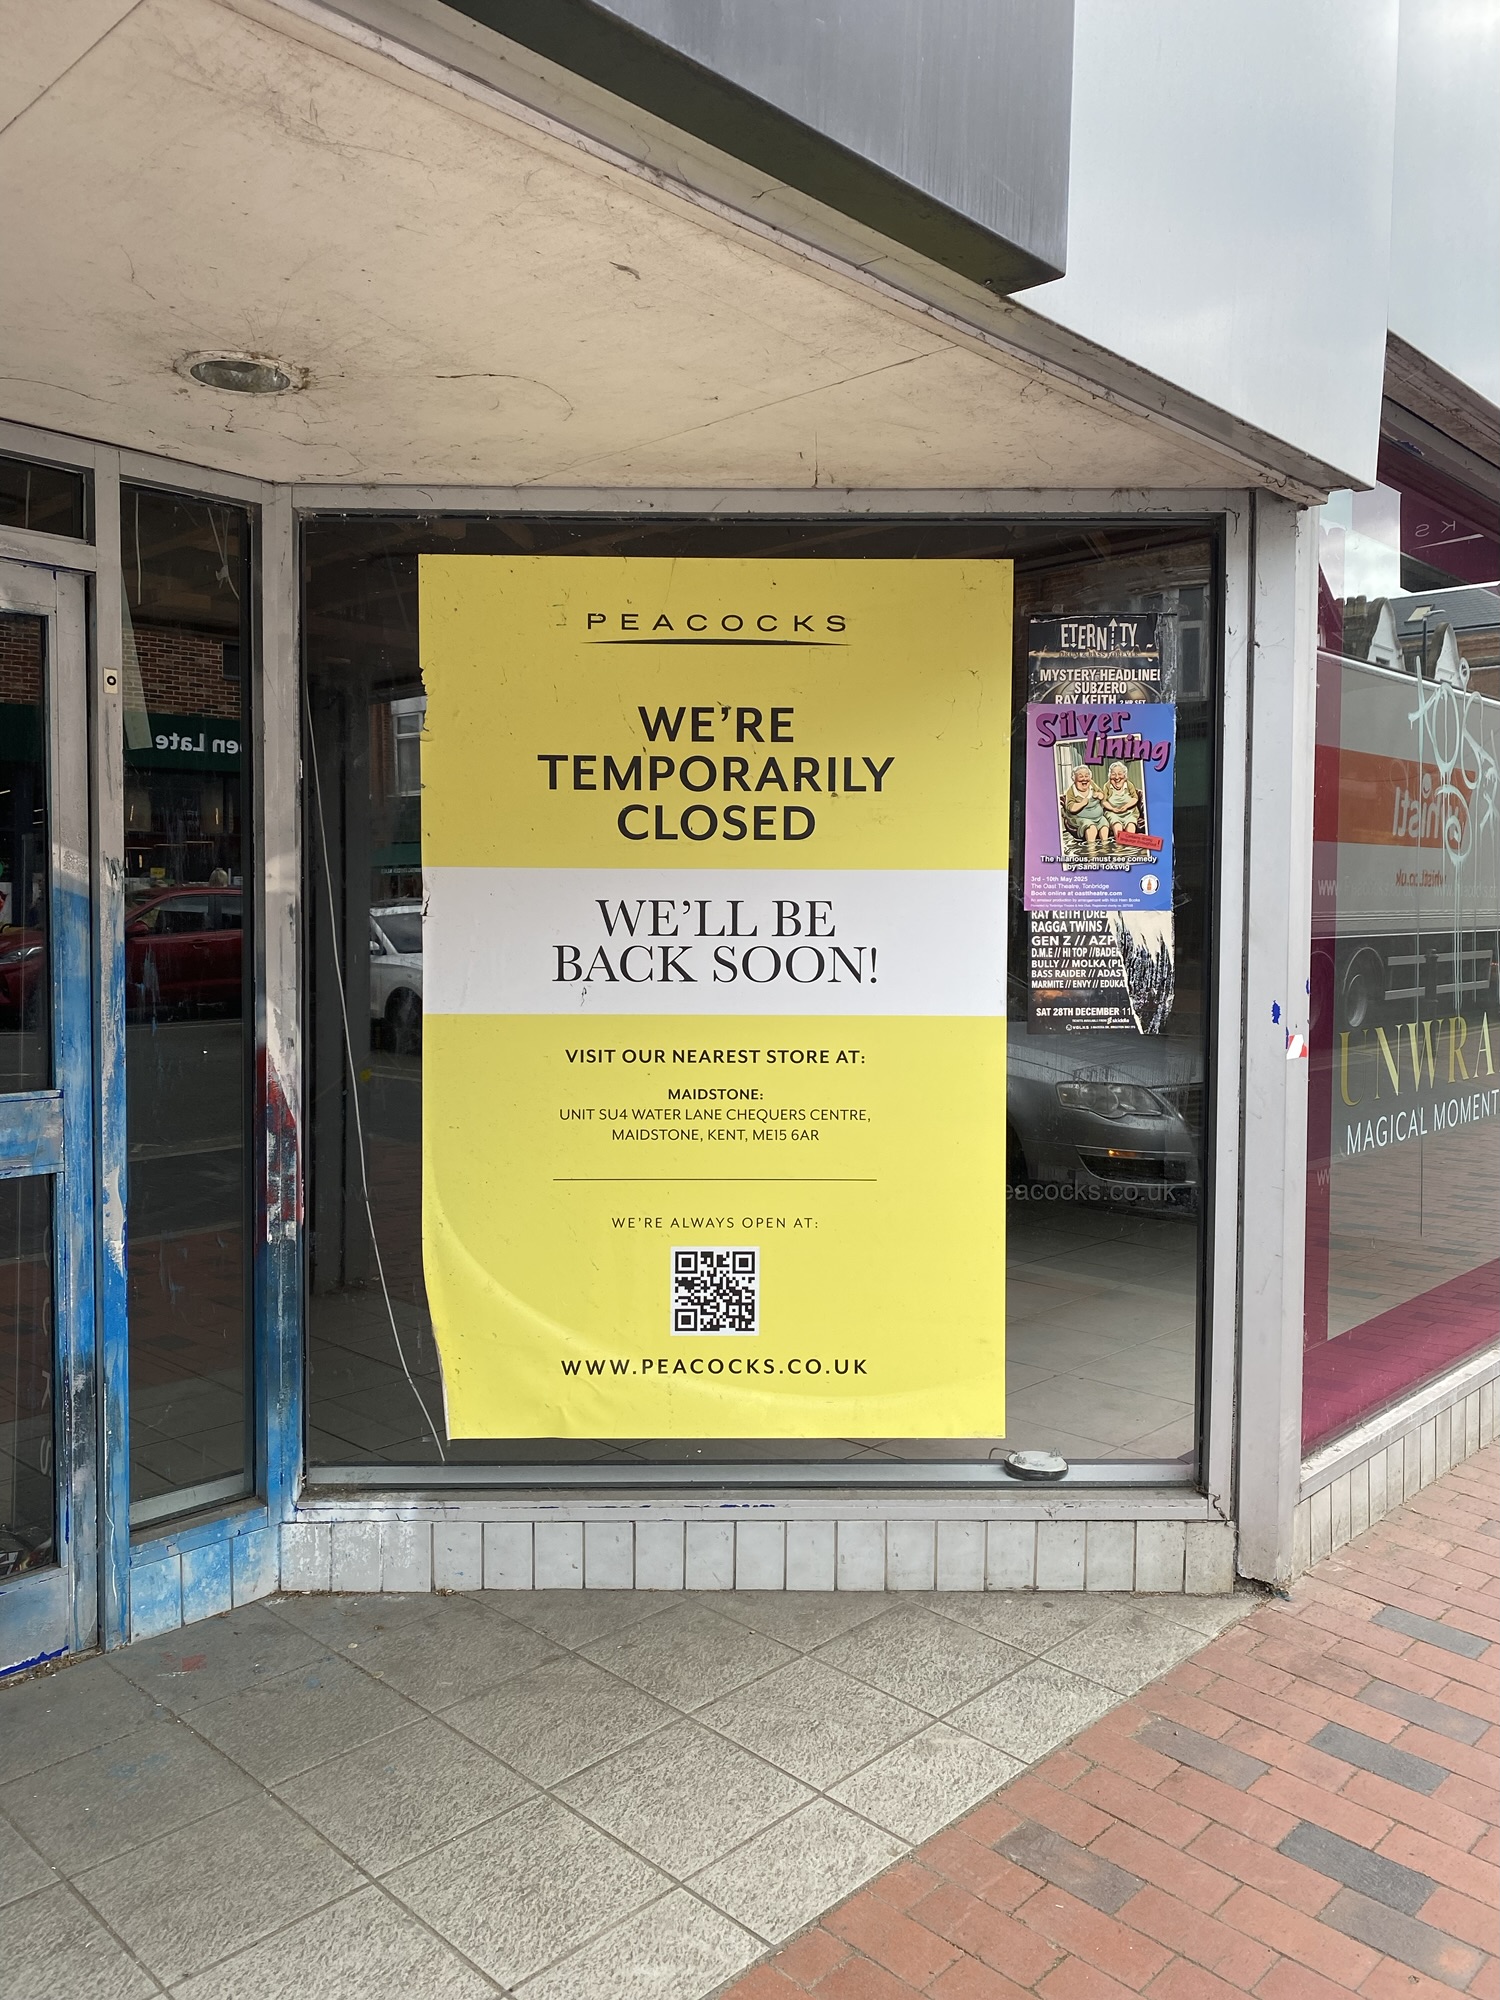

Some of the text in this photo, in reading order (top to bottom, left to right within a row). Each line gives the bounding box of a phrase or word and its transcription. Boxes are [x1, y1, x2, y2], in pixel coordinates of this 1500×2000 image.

[587, 613, 847, 633] PEACOCKS
[1061, 618, 1137, 650] ETERNITY
[1040, 669, 1096, 681] MYSTERY
[1074, 682, 1127, 694] SUBZERO
[1055, 695, 1079, 704] RAY
[1082, 695, 1117, 704] KEITH
[638, 706, 795, 742] WE'RE
[1036, 710, 1131, 747] Silver
[1085, 731, 1171, 771] Lining
[538, 755, 895, 793] TEMPORARILY
[617, 804, 816, 841] CLOSED
[1041, 855, 1054, 863] The
[1093, 855, 1111, 863] must
[1127, 855, 1157, 864] comedy
[1067, 863, 1130, 872] by Sandi Toksvig
[1082, 883, 1110, 891] Tonbridge
[595, 899, 836, 937] WE'LL BE
[1032, 910, 1107, 920] RAY KEITH (DRE
[1032, 921, 1067, 932] RAGGA
[1070, 921, 1102, 932] TWINS
[1031, 936, 1059, 946] GEN
[1063, 936, 1071, 945] Z
[1074, 935, 1086, 946] //
[1032, 948, 1053, 957] D.M.E
[1054, 947, 1062, 958] //
[1063, 948, 1071, 957] HI
[1072, 948, 1087, 957] TOP
[552, 945, 877, 983] BACK SOON!
[1032, 960, 1059, 968] BULLY
[1061, 959, 1070, 968] //
[1072, 960, 1106, 968] MOLKA
[1032, 970, 1053, 978] BASS
[1055, 970, 1086, 978] RAIDER
[1088, 969, 1096, 978] //
[1032, 980, 1064, 988] MARMITE
[1065, 980, 1072, 988] //
[1073, 980, 1092, 988] ENVY
[1092, 980, 1099, 988] //
[1036, 1008, 1052, 1016] SAT
[1053, 1008, 1074, 1016] 28TH
[1075, 1007, 1120, 1016] DECEMBER
[565, 1049, 866, 1065] VISIT OUR NEAREST STORE AT:
[668, 1088, 764, 1100] MAIDSTONE:
[559, 1108, 871, 1123] UNIT SU4 WATER LANE CHEQUERS CENTRE,
[1347, 1089, 1500, 1155] MAGICAL MOMENT
[612, 1128, 820, 1142] MAIDSTONE, KENT, ME15 6AR
[611, 1217, 819, 1229] WE'RE ALWAYS OPEN AT:
[560, 1358, 868, 1376] WWW.PEACOCKS.CO.UK
